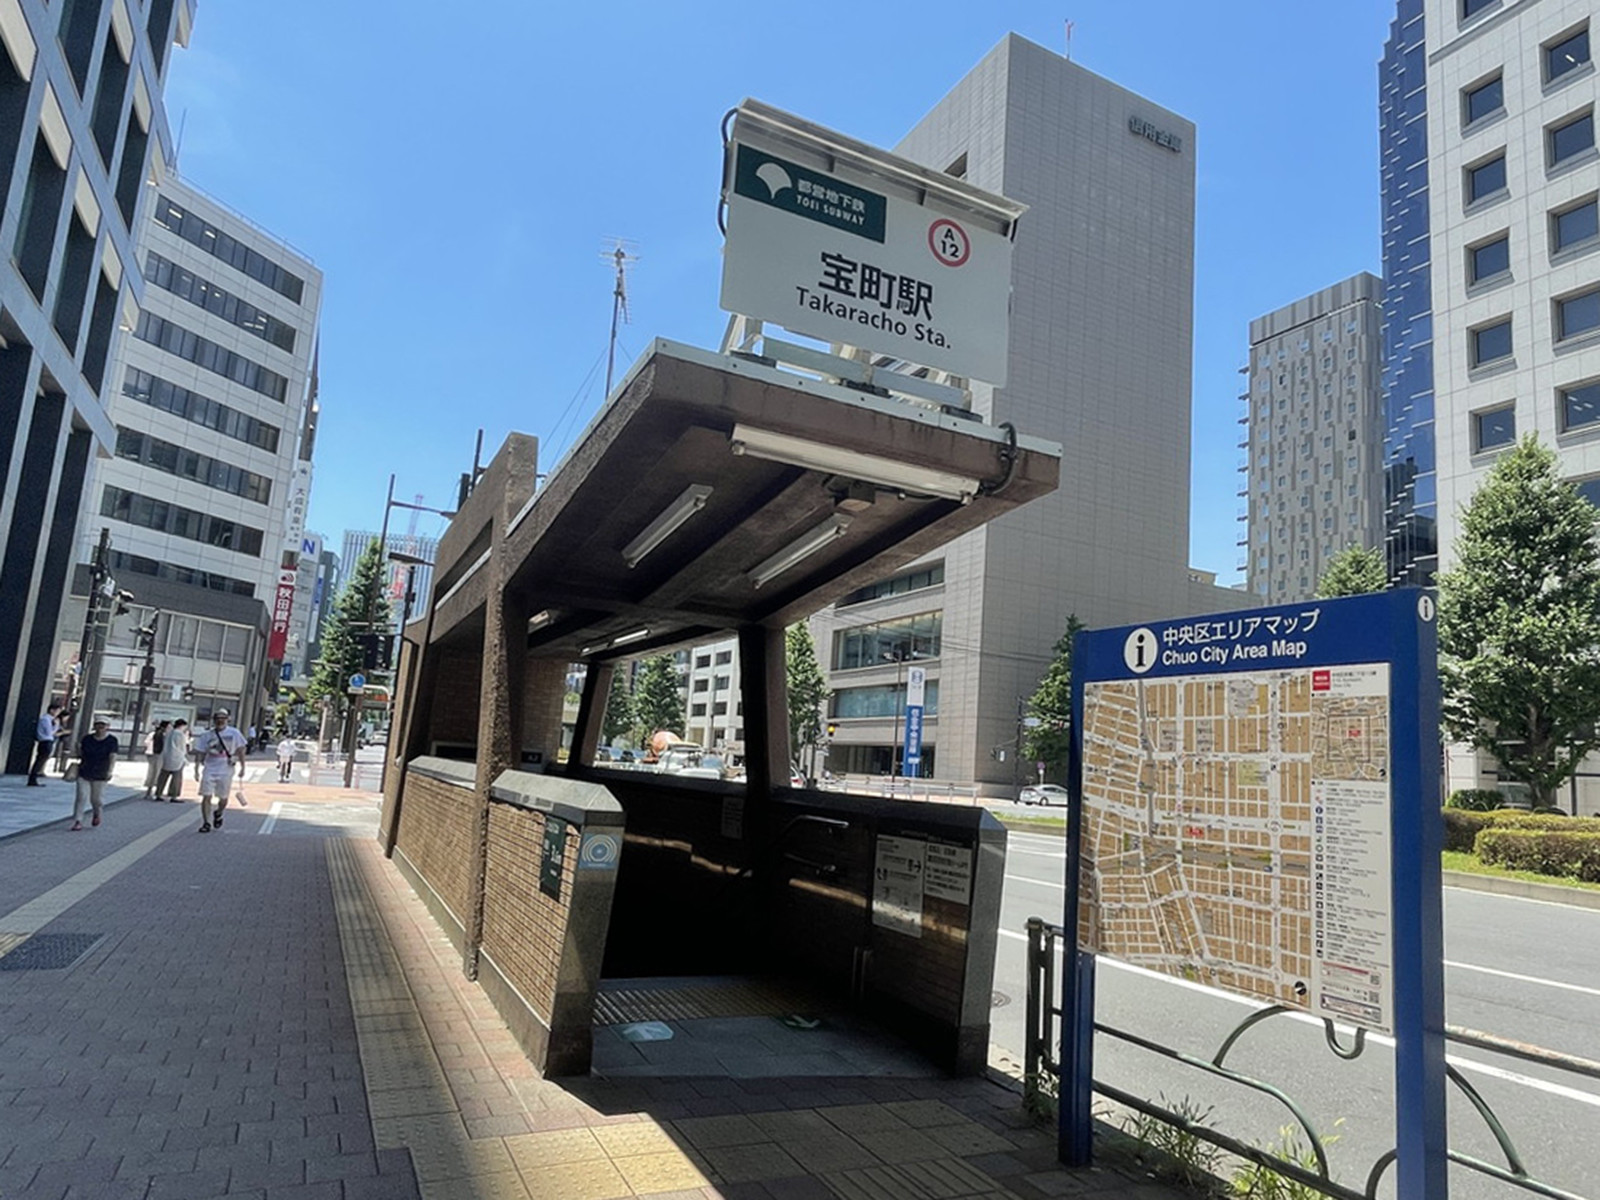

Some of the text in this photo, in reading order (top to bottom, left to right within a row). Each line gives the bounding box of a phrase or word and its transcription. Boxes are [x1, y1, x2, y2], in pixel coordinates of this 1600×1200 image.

[796, 195, 865, 226] TOEI SUBWAY
[798, 179, 865, 213] 都営地下鉄
[941, 240, 959, 259] 12
[944, 228, 955, 242] A
[818, 252, 933, 321] 宝町駅
[796, 286, 952, 350] Takaracho Sta.
[274, 588, 292, 633] 秋田銀行
[1163, 608, 1321, 647] 中央区エリアマップ
[1162, 640, 1307, 666] Chuo City Area Map
